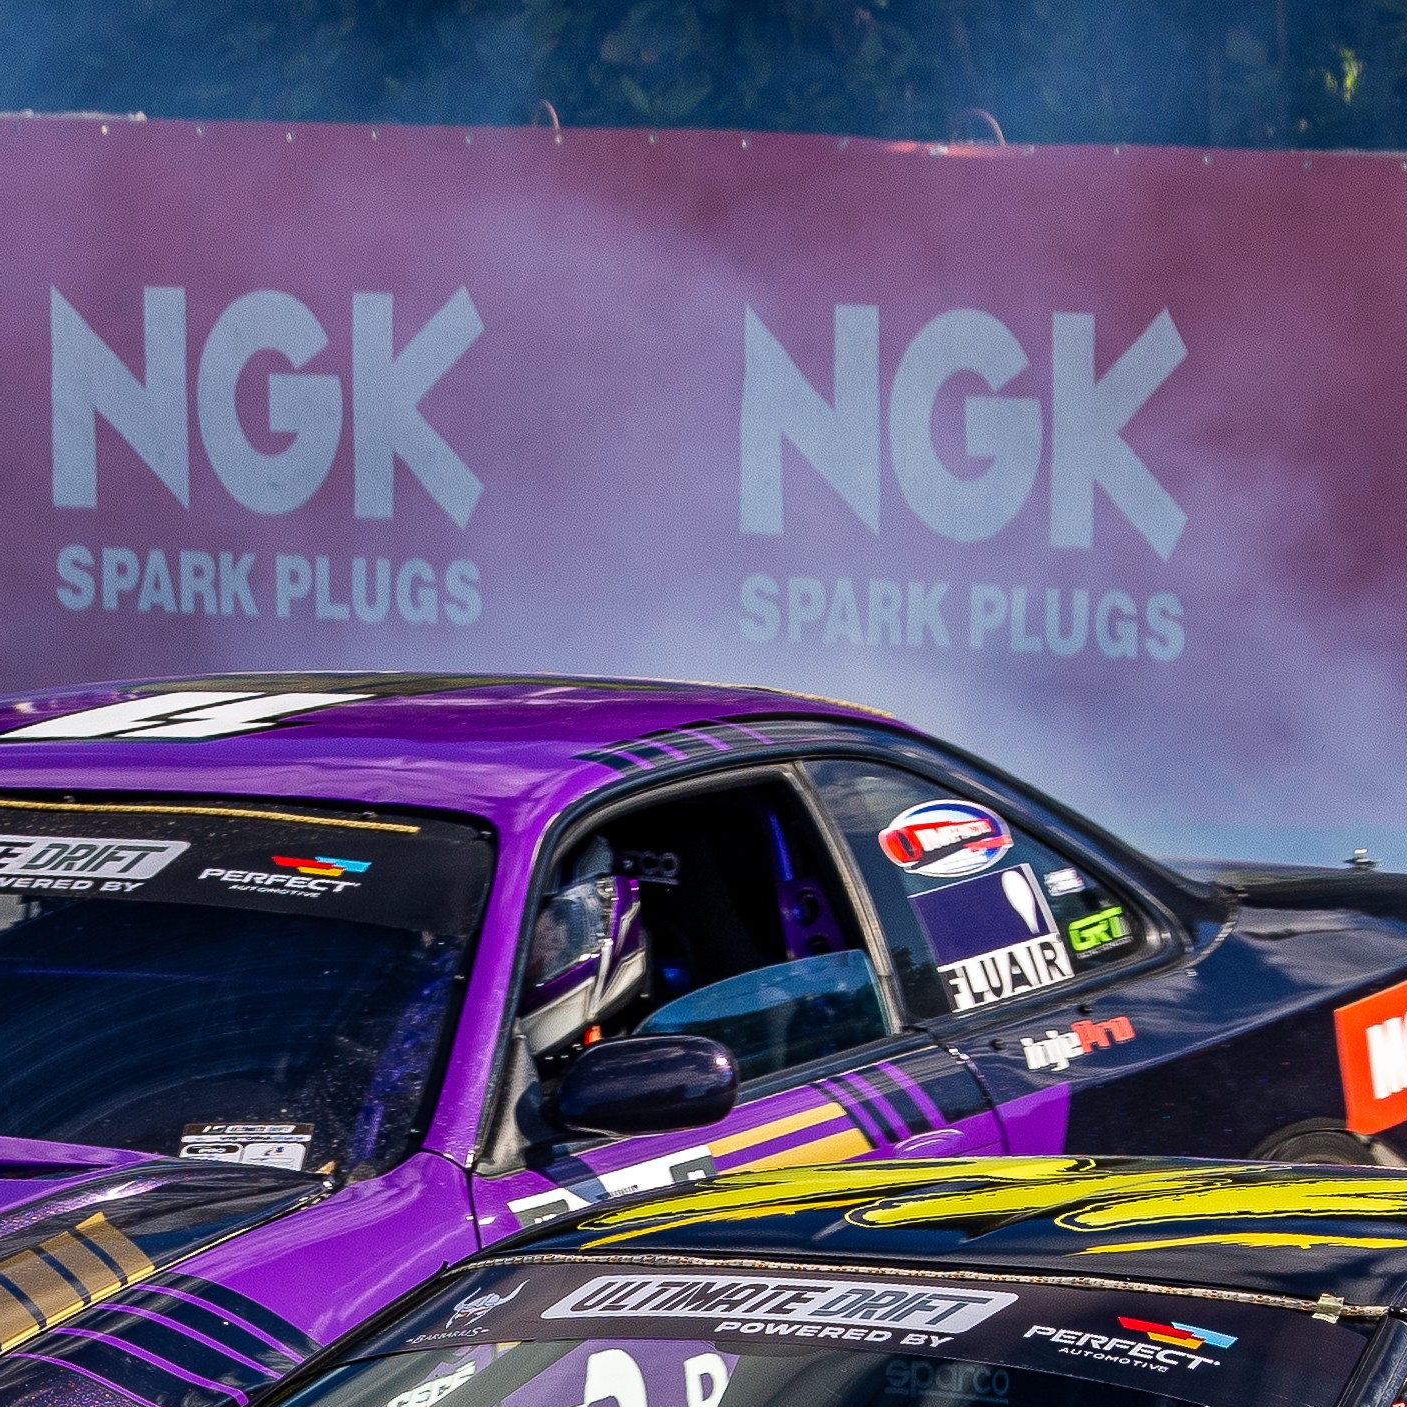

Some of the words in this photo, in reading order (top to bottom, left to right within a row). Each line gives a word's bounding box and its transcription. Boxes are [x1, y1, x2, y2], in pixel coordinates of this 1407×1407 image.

[50, 284, 486, 529] NGK
[738, 303, 1189, 562] NGK
[56, 544, 260, 617] SPARK
[275, 554, 484, 626] PLUGS
[738, 573, 954, 649] SPARK
[969, 589, 1187, 662] PLUGS
[19, 843, 166, 875] DRIFT
[99, 881, 145, 893] BY
[197, 868, 358, 893] PERFECT
[228, 884, 322, 898] AUTOMOTIVE
[574, 1280, 836, 1316] ULTIMATE
[812, 1287, 993, 1326] DRIFT
[714, 1321, 893, 1344] POWERED
[901, 1333, 954, 1349] BY
[1023, 1324, 1215, 1371] PERFECT
[885, 1359, 1010, 1398] sparco
[1058, 1347, 1170, 1373] AUTOMOTIVE
